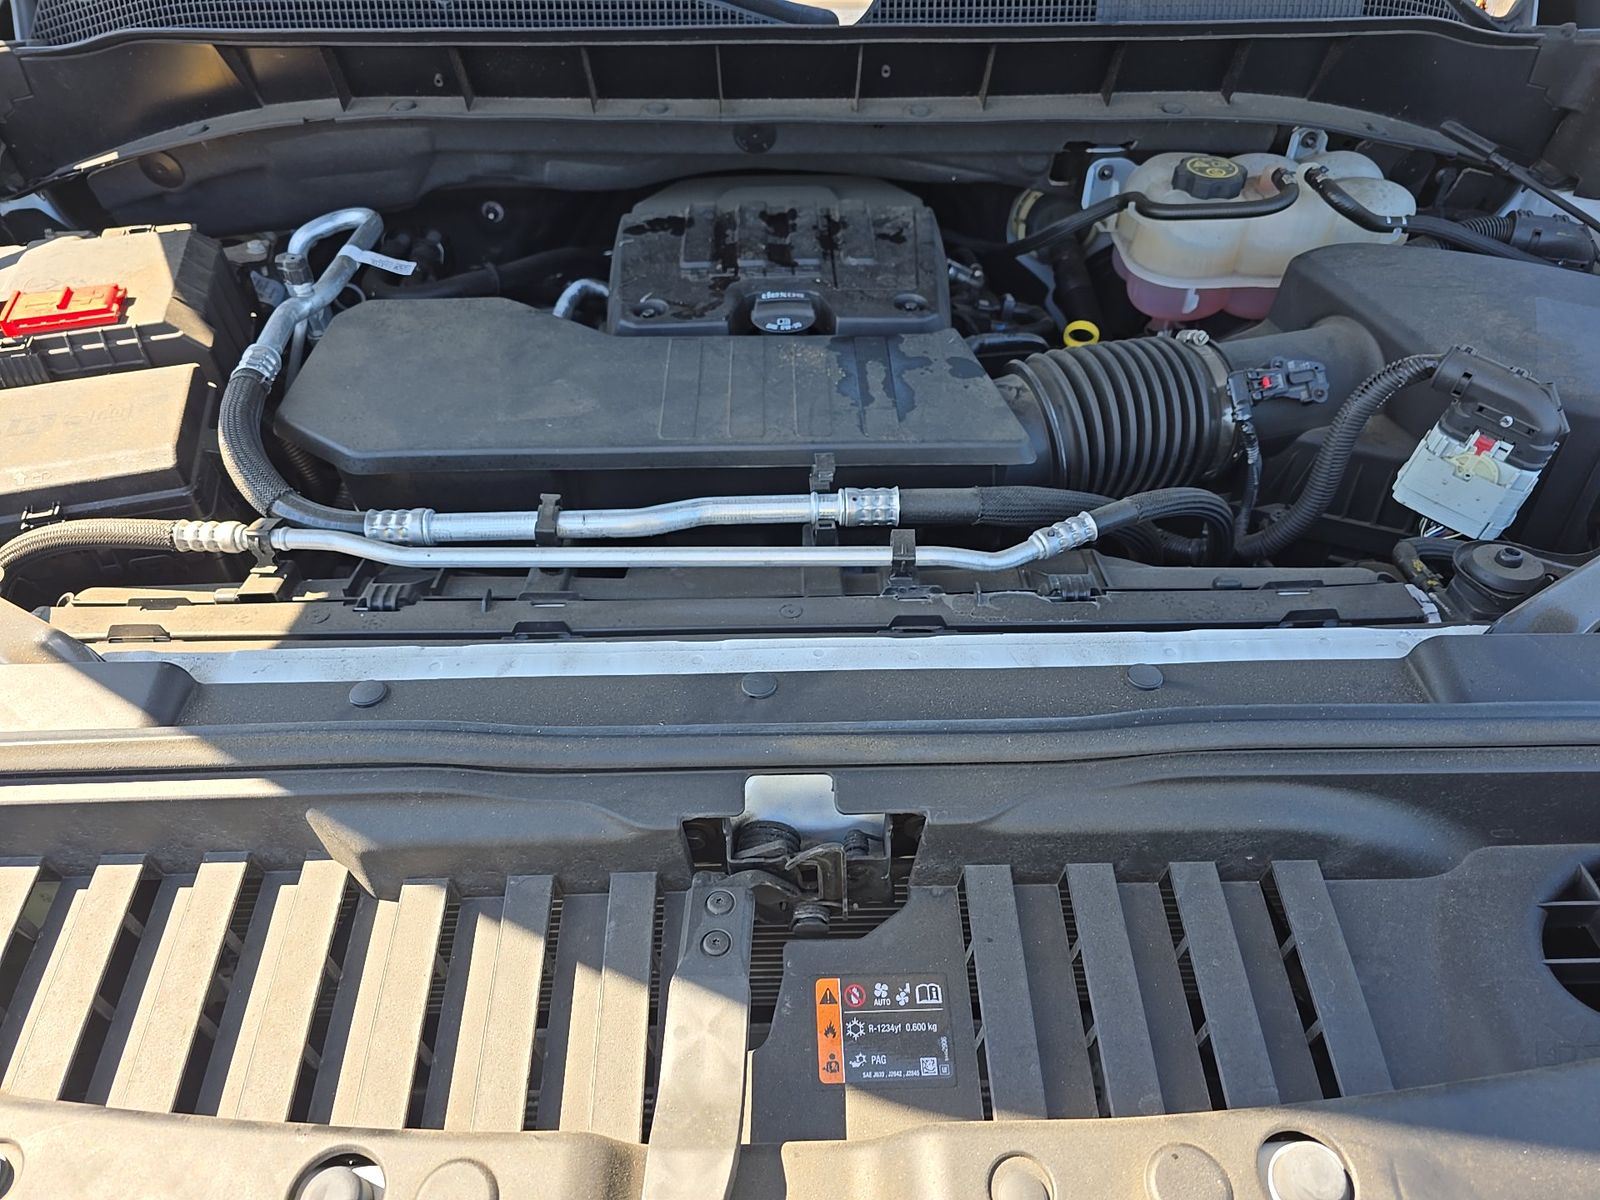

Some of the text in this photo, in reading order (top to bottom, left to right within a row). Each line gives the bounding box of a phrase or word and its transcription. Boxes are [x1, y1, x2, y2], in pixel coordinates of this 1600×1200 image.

[873, 998, 891, 1006] AUTO
[868, 1022, 937, 1033] R-1234yf 0.600 kg
[871, 1055, 887, 1065] PAG
